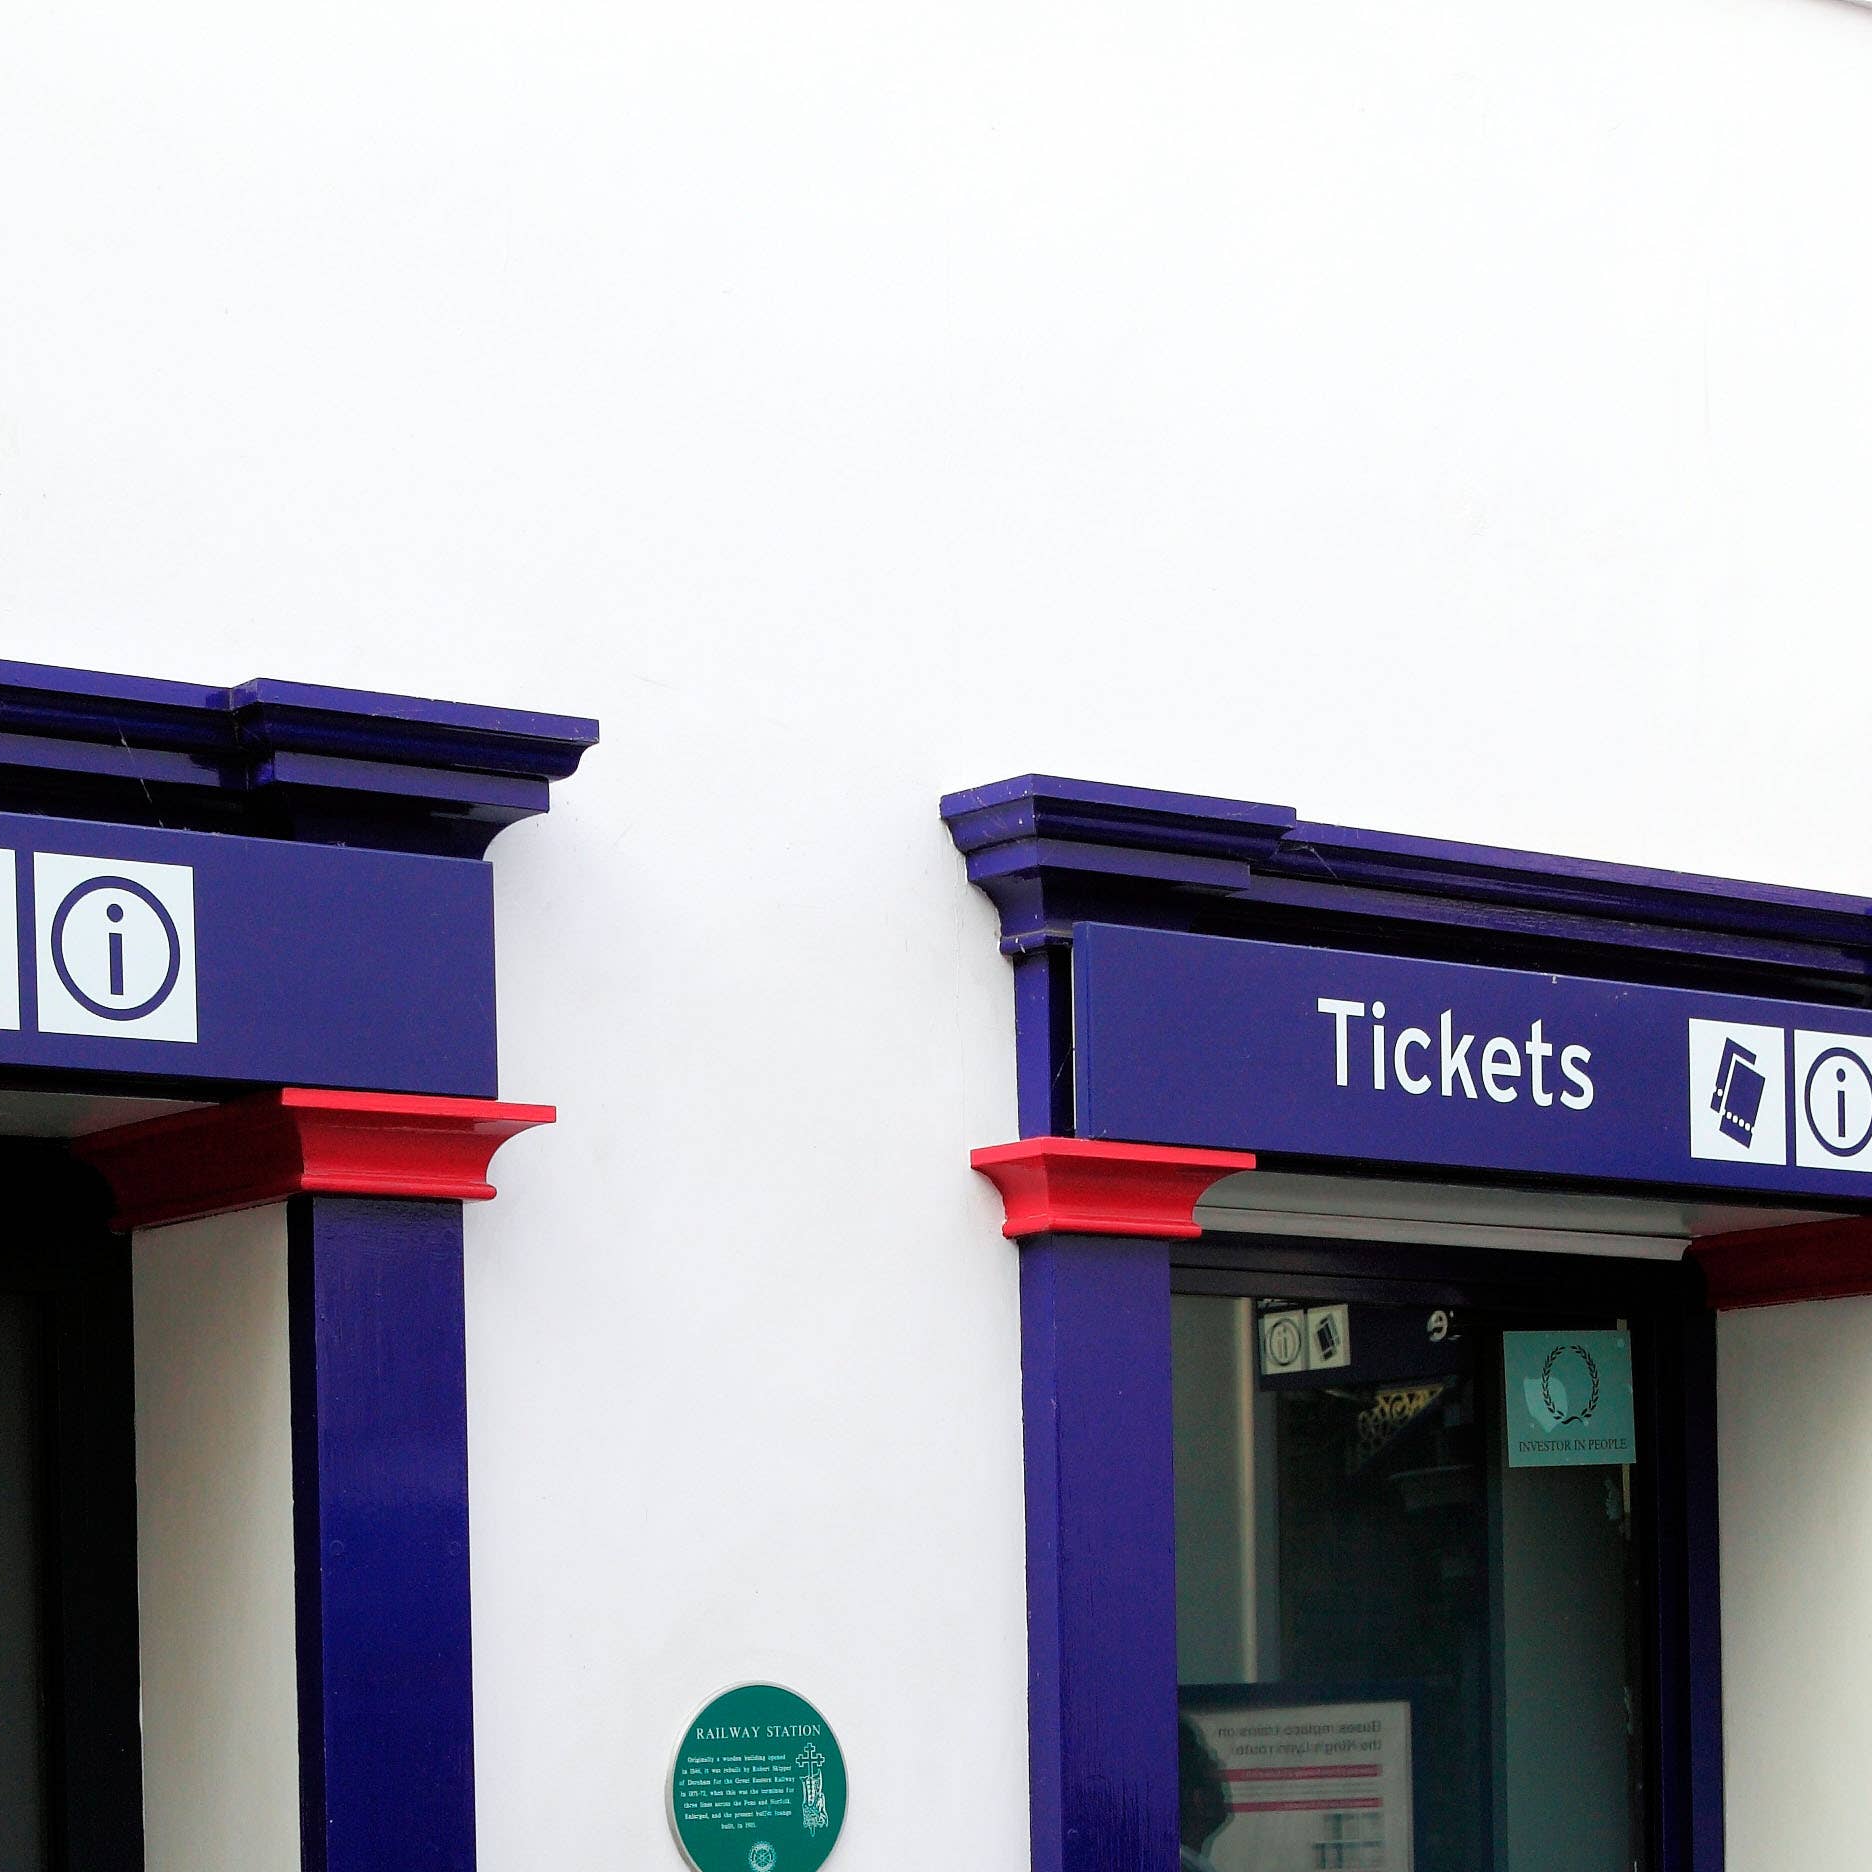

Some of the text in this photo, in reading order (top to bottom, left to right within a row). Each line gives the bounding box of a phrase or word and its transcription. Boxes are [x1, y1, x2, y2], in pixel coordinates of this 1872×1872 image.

[1317, 996, 1596, 1111] Tickets
[1520, 1438, 1628, 1452] INVESTOR IN PEOPLE
[696, 1724, 821, 1739] RAILWAY STATION
